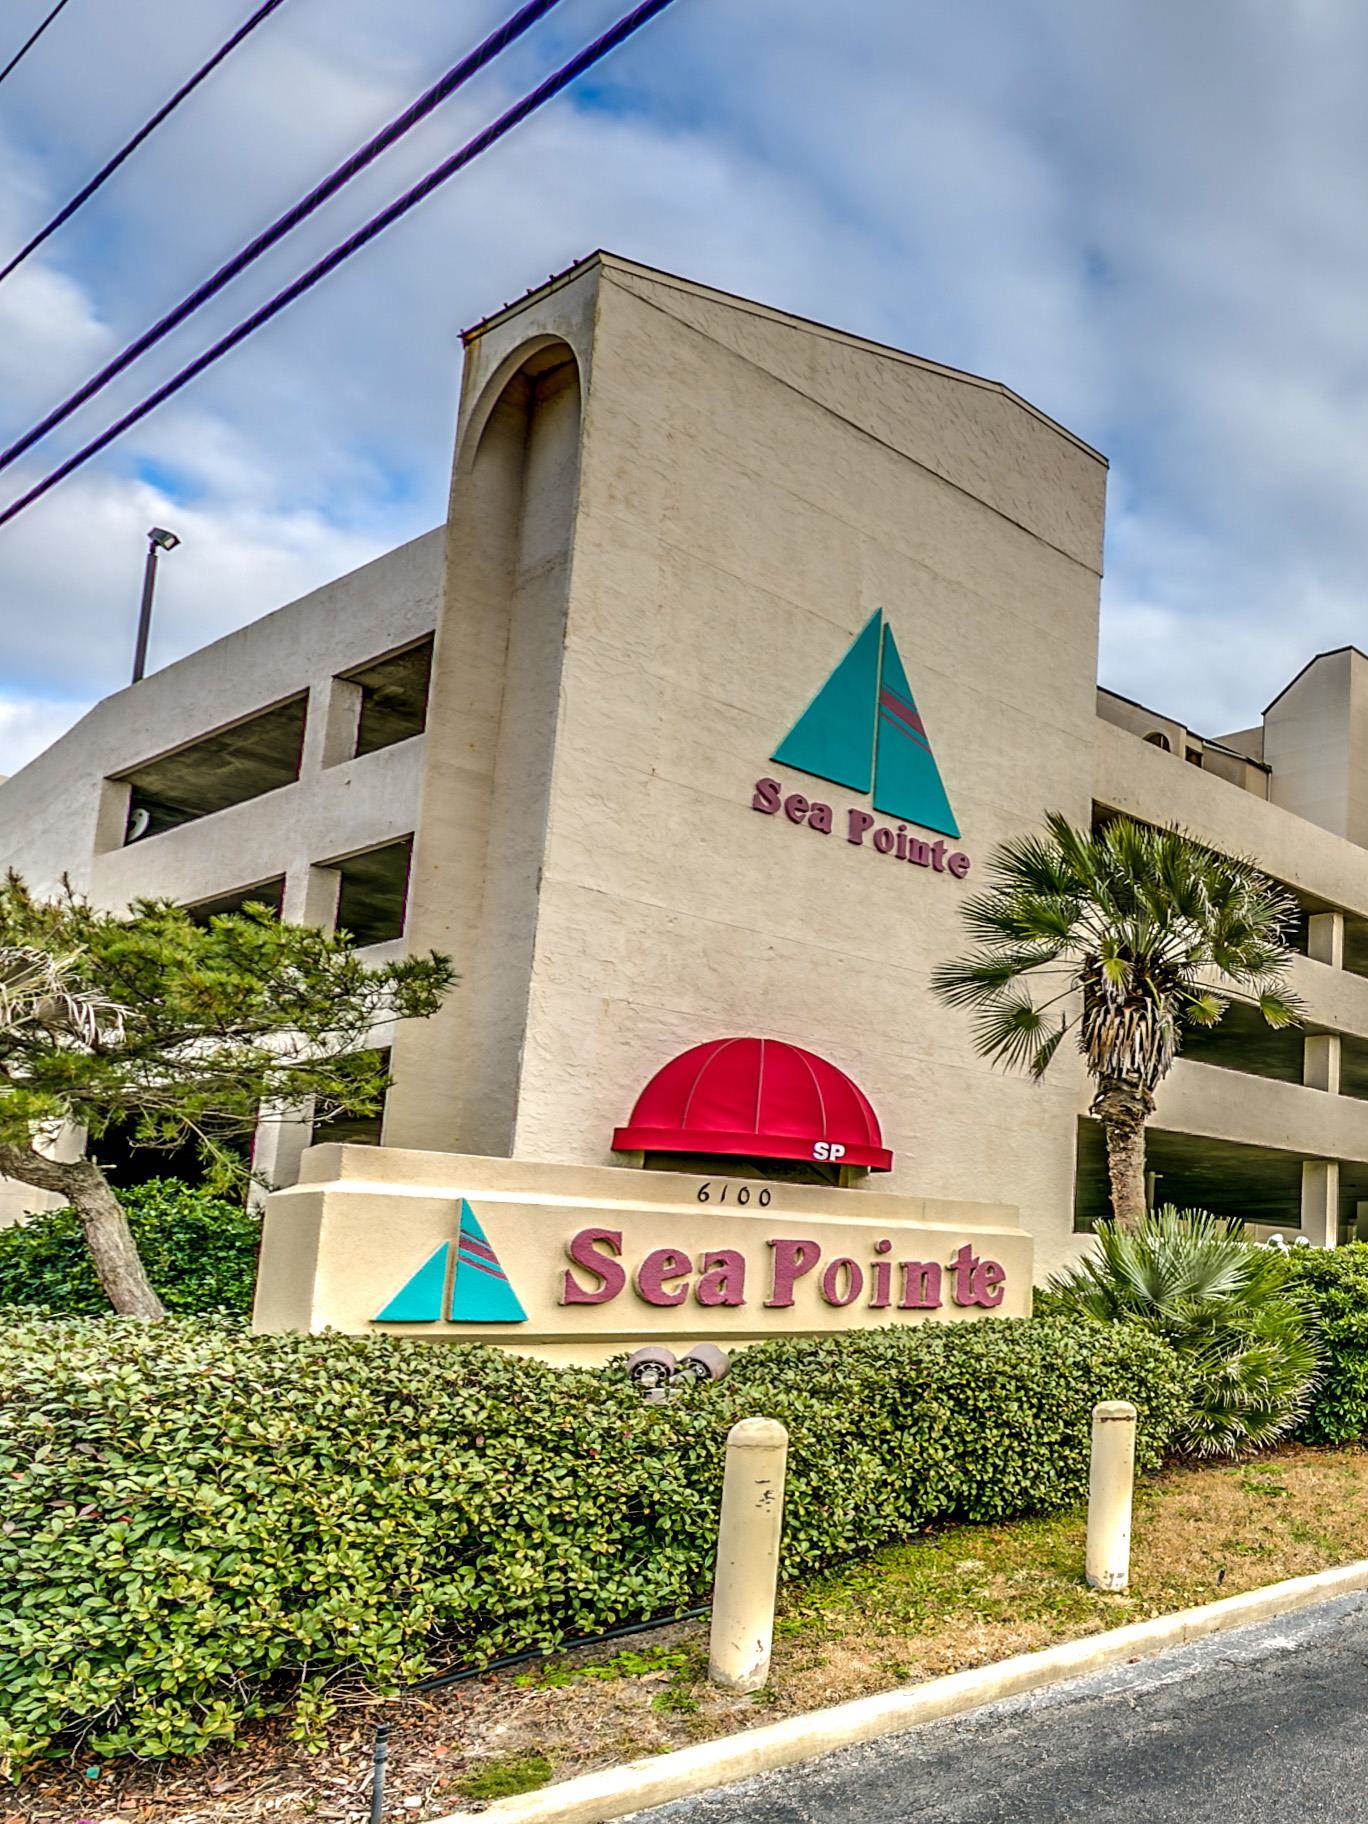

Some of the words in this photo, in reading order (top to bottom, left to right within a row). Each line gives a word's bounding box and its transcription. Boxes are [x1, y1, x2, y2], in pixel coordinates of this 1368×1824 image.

[752, 777, 832, 834] Sea
[847, 807, 970, 879] Pointe
[813, 1141, 846, 1162] SP
[697, 1182, 771, 1207] 6100
[558, 1227, 747, 1306] Sea
[763, 1238, 1006, 1308] Pointe
